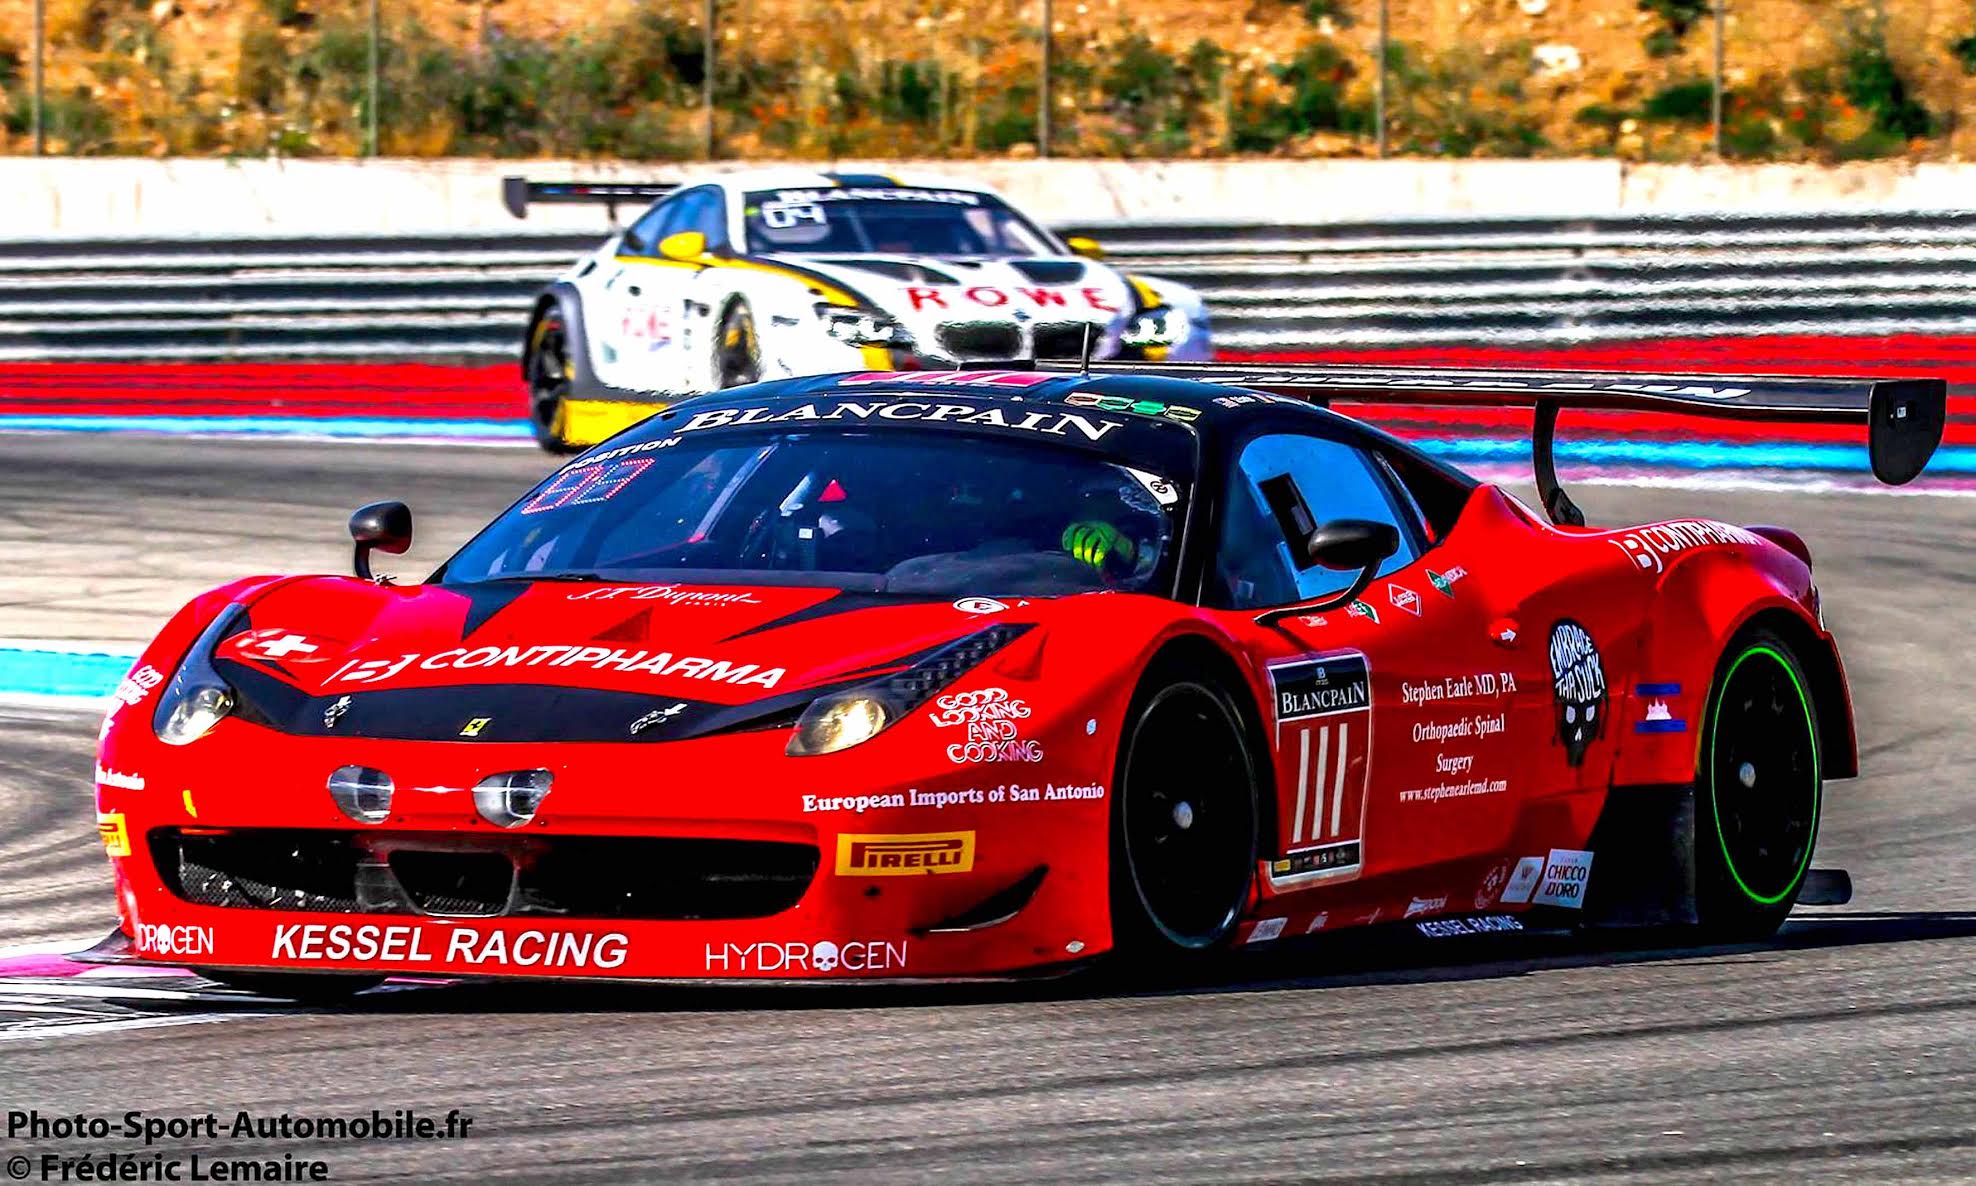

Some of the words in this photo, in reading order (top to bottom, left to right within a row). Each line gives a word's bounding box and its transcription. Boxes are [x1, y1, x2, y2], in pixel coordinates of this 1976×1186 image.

[903, 286, 1120, 313] ROWE
[673, 401, 1125, 442] BLANCPAIN
[558, 436, 682, 475] POSITION
[629, 583, 762, 606] Dupont
[420, 644, 787, 689] CONTIPHARMA
[1549, 623, 1594, 680] EMBRACE
[1402, 680, 1445, 707] Stephen
[1445, 676, 1474, 699] Earle
[1474, 673, 1500, 700] MD,
[1500, 671, 1518, 693] PA
[1574, 652, 1606, 704] SUCK
[936, 687, 1009, 710] GOOD
[1281, 680, 1366, 714] BLANCPAIN
[928, 699, 1032, 728] LOOKING
[1412, 716, 1473, 744] Orthopaedic
[1474, 712, 1505, 740] Spinal
[967, 719, 1018, 742] AND
[946, 740, 1044, 763] COOKING
[1435, 752, 1474, 776] Surgery
[802, 793, 905, 813] European
[908, 786, 984, 809] Imports
[988, 784, 1005, 802] of
[1009, 783, 1040, 801] San
[1044, 781, 1105, 800] Antonio
[1399, 777, 1508, 804] www.stephenearlemd.com
[850, 838, 964, 869] PIRELLI
[1547, 864, 1587, 882] CHICCO
[1415, 918, 1476, 938] KESSEL
[1466, 915, 1524, 934] RACING
[271, 924, 432, 963] KESSEL
[445, 928, 629, 970] RACING
